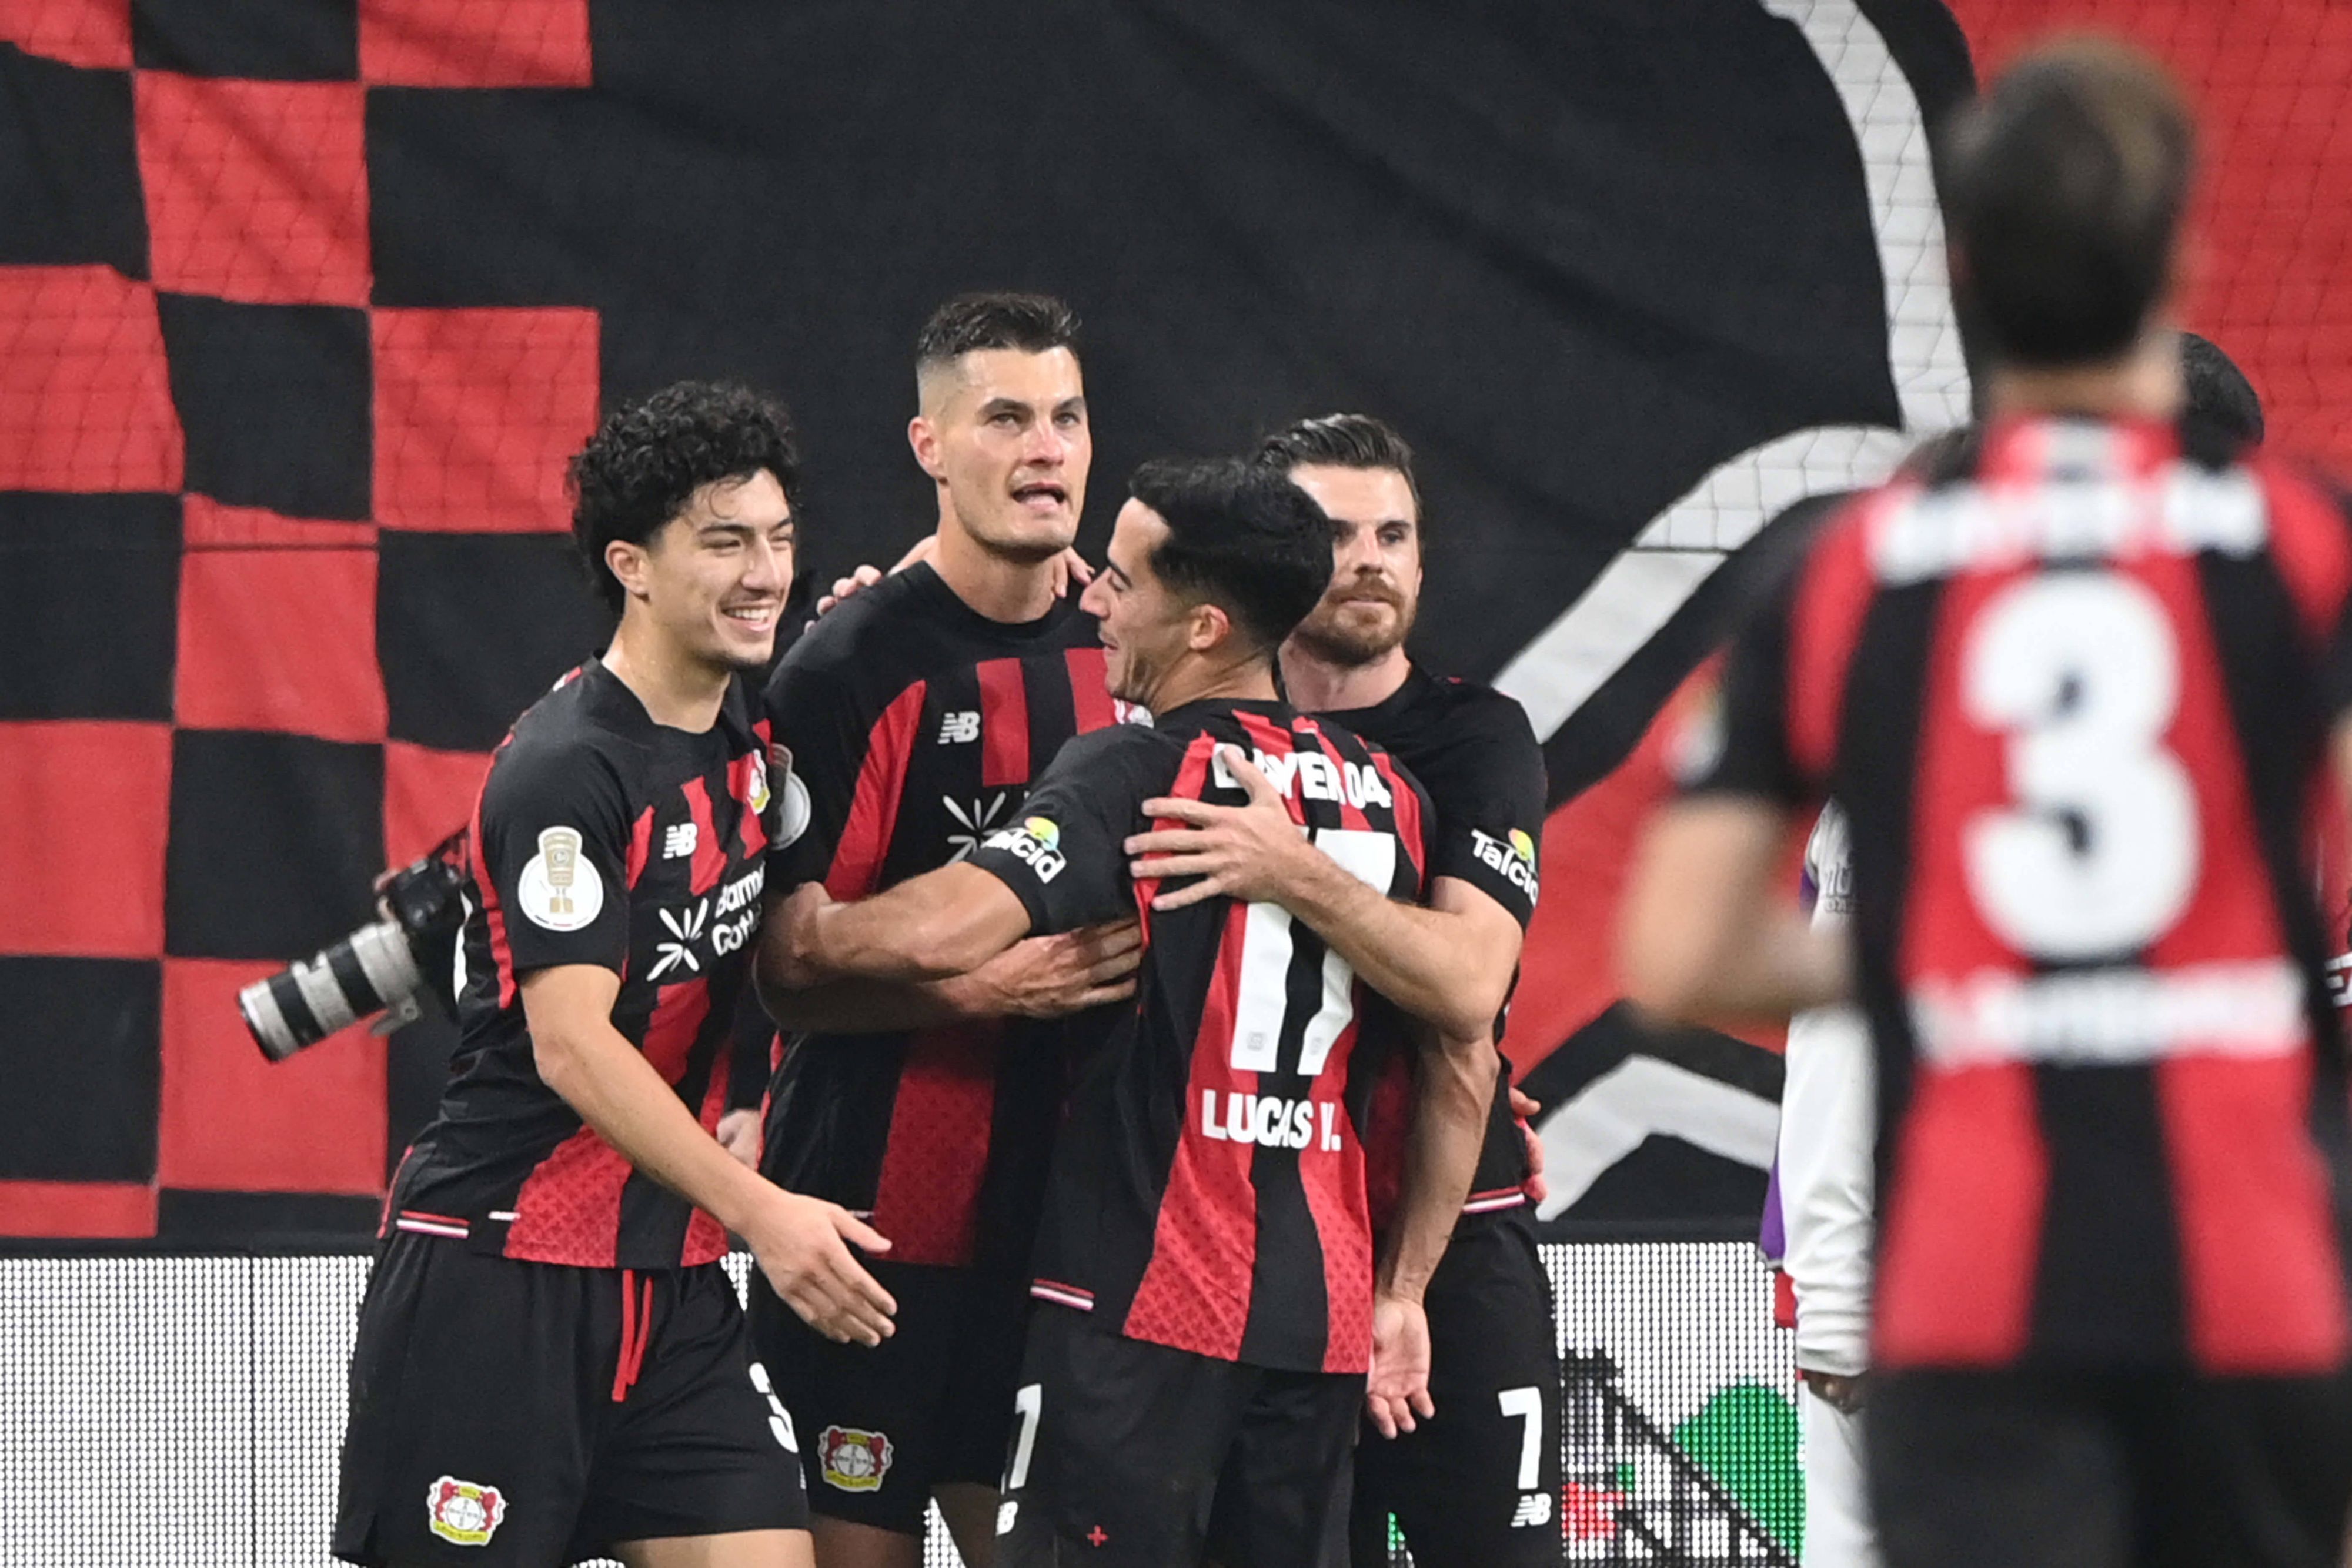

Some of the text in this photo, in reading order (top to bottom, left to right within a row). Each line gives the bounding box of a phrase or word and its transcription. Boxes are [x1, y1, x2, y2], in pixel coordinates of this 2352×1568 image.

[1343, 761, 1392, 810] 04
[1959, 570, 2203, 959] 3
[1230, 825, 1396, 1076] 17
[1202, 1089, 1342, 1152] LUCAS I.
[1498, 1386, 1542, 1490] 7
